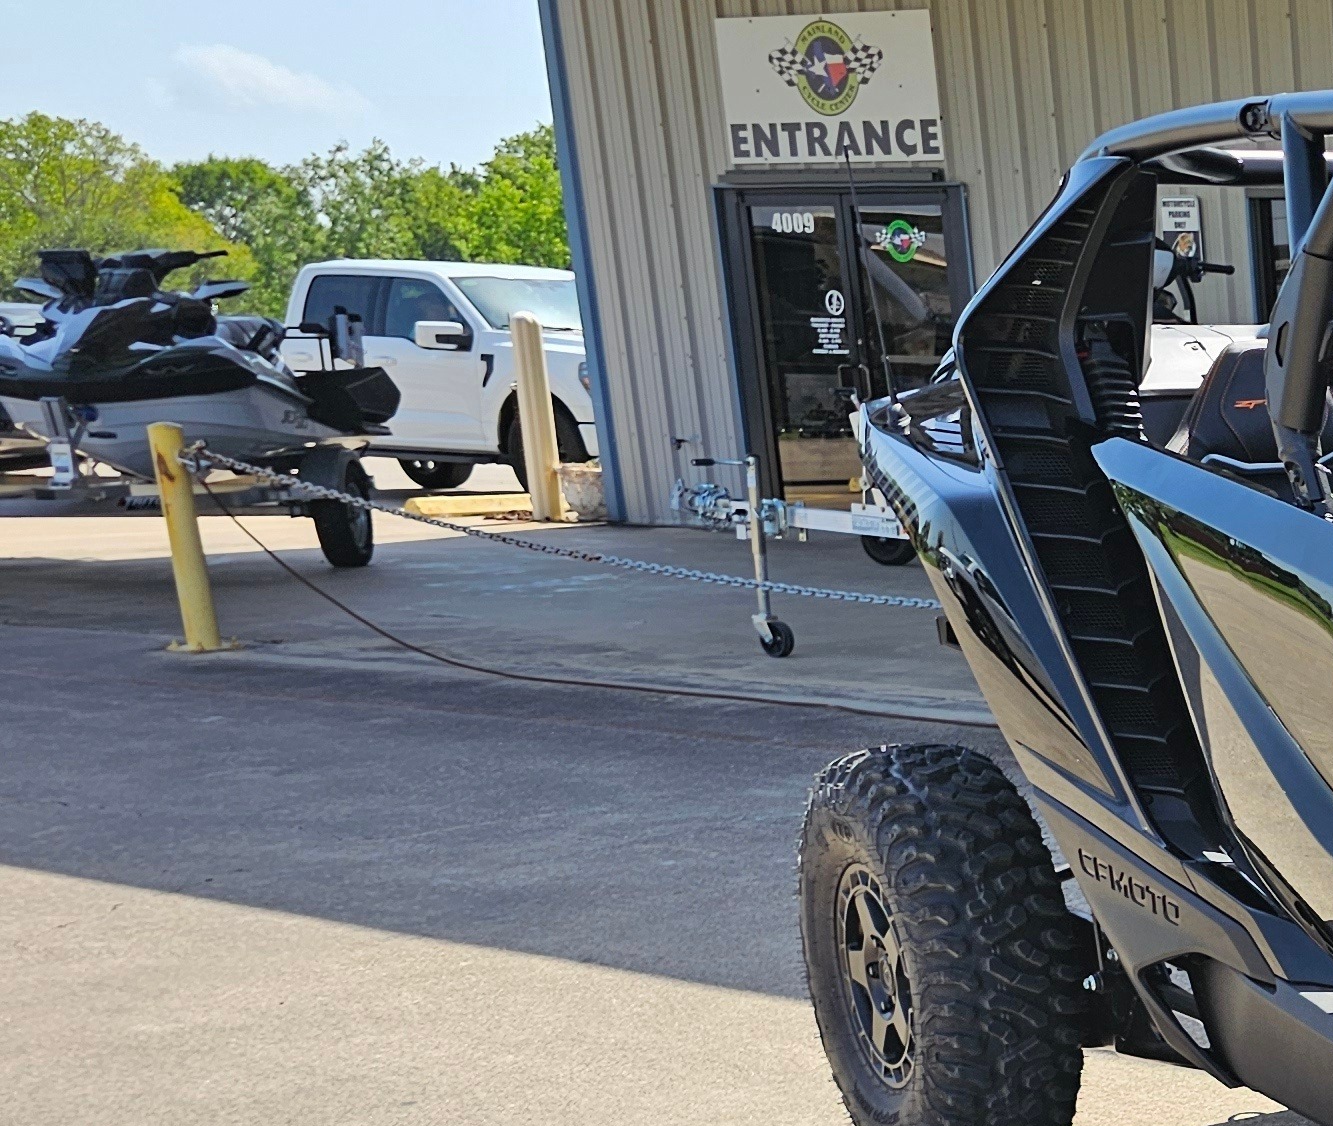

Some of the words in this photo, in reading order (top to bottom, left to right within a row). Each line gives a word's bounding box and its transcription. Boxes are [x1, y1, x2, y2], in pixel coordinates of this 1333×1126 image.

[800, 24, 846, 45] MAINLAND
[802, 85, 826, 110] CYCLE
[829, 84, 856, 111] CENTER
[730, 118, 941, 158] ENTRANCE
[771, 212, 815, 234] 4009
[1078, 848, 1180, 926] CFMOTO
